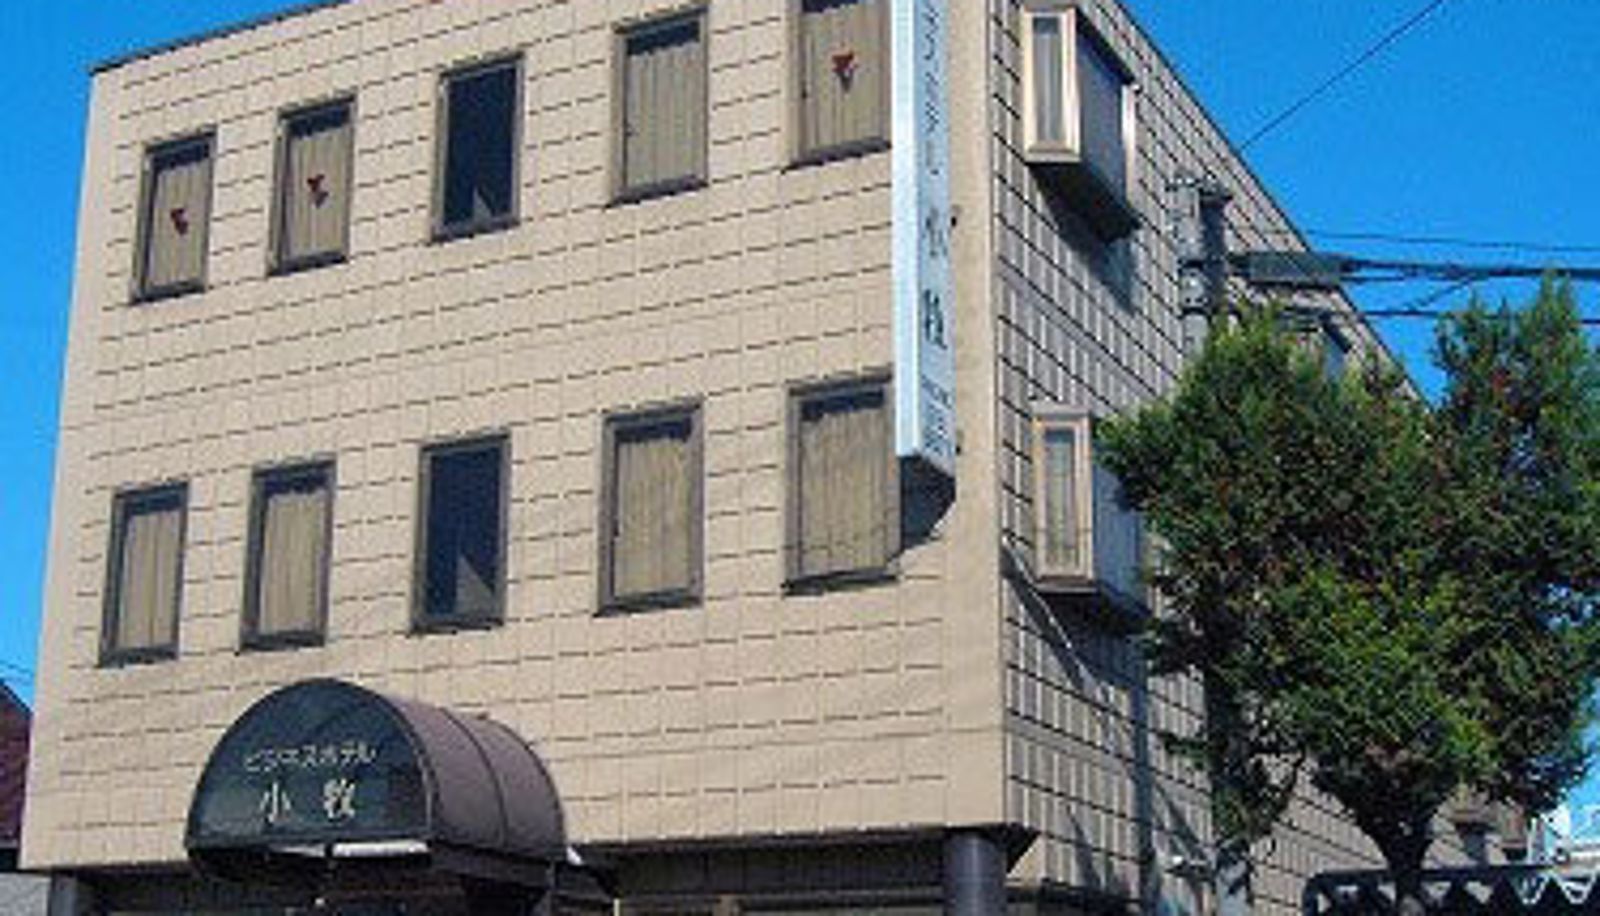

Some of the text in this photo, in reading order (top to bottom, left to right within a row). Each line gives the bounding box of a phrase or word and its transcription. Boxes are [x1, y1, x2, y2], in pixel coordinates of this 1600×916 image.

[244, 742, 377, 773] ビジネスホテル
